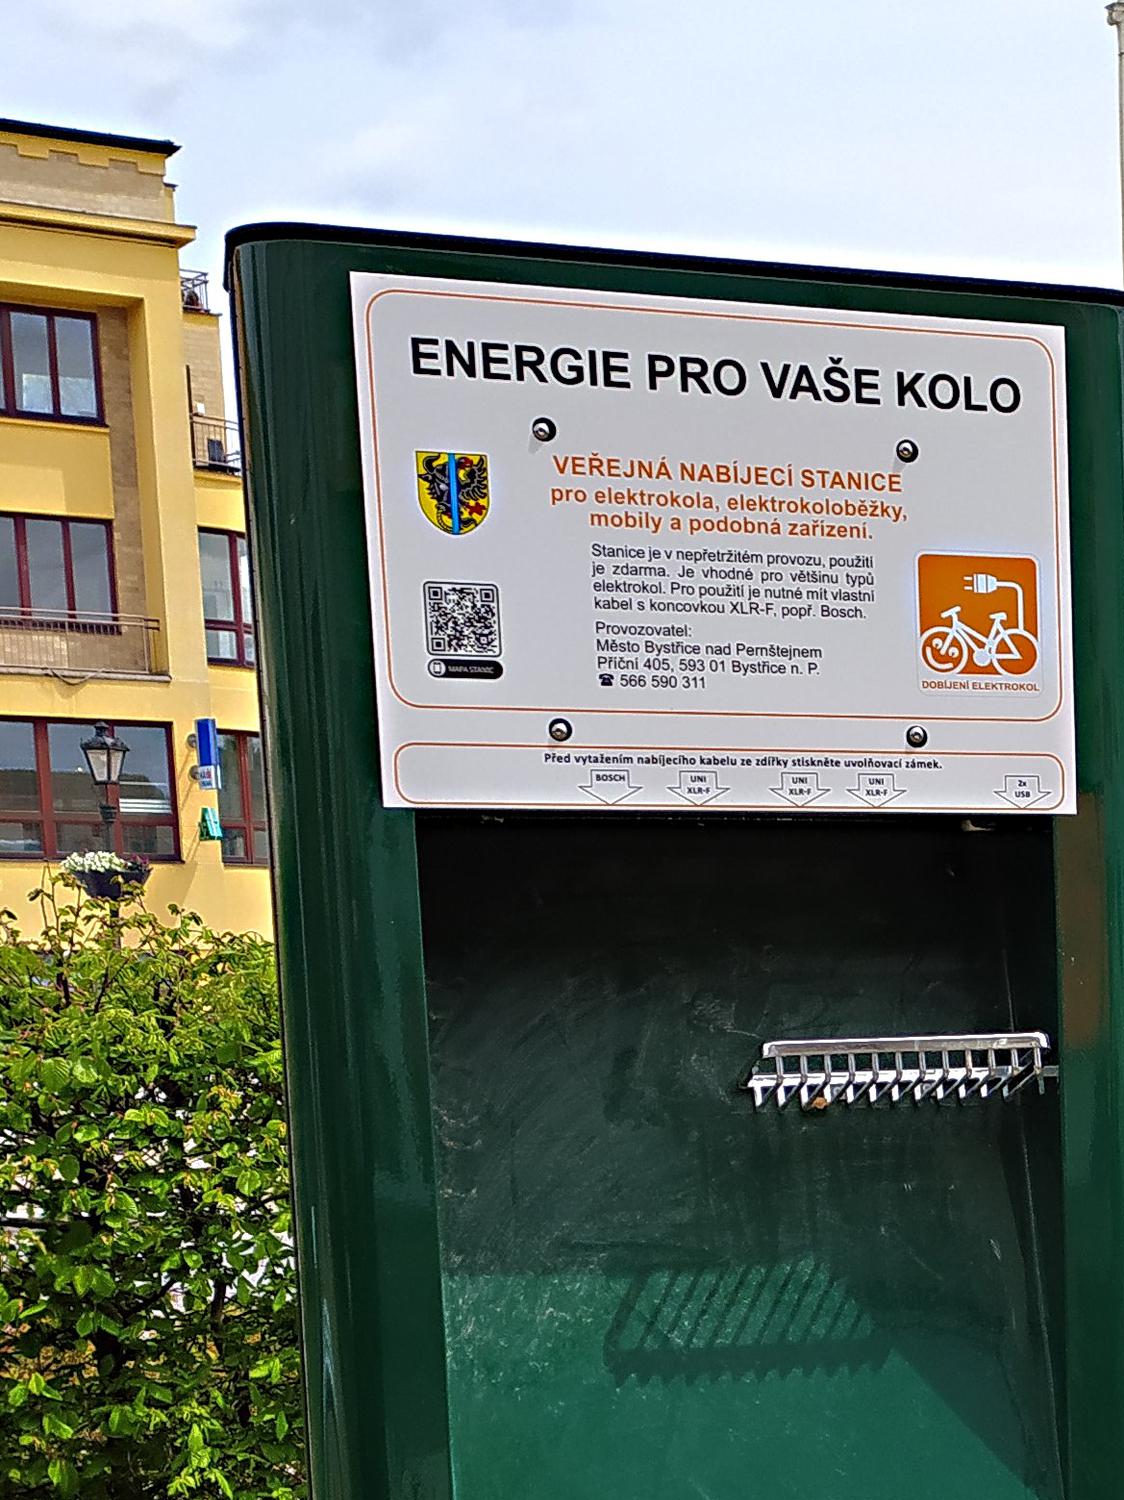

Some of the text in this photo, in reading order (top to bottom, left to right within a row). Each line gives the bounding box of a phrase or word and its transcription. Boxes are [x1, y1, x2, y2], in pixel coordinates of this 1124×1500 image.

[410, 336, 1021, 413] ENERGIE PRO VAŠE KOLO
[553, 453, 902, 492] VEŘEJNÁ NABÍJECÍ STANICE
[551, 487, 907, 522] pro elektrokola, elektrokoloběžky,
[590, 511, 873, 539] mobily a podobná zařízení.
[591, 543, 873, 569] Stanice je v nepřetržitém provozu, použití
[592, 561, 874, 587] je zdarma. Je vhodné pro většinu typů
[593, 579, 875, 602] elektrokol. Pro použití je nutné mít vlastní
[594, 596, 866, 619] kabel s koncovkou XLR-F, popř. Bosch.
[595, 621, 692, 637] Provozovatel:
[596, 638, 822, 660] Město Bystřice nad Pernštejnem
[597, 656, 820, 676] Příční 405, 593 01 Bystřice n. P.
[620, 675, 706, 689] 566 590 311
[922, 680, 1040, 691] DOBÍJENÍ ELEKTROKOL
[544, 753, 943, 769] Před vytažením nabíjecího kabelu ze zdířky stiskněte uvolňovací zámek.
[595, 774, 626, 782] BOSCH
[690, 775, 706, 783] UNI
[788, 788, 812, 796] XLR-F
